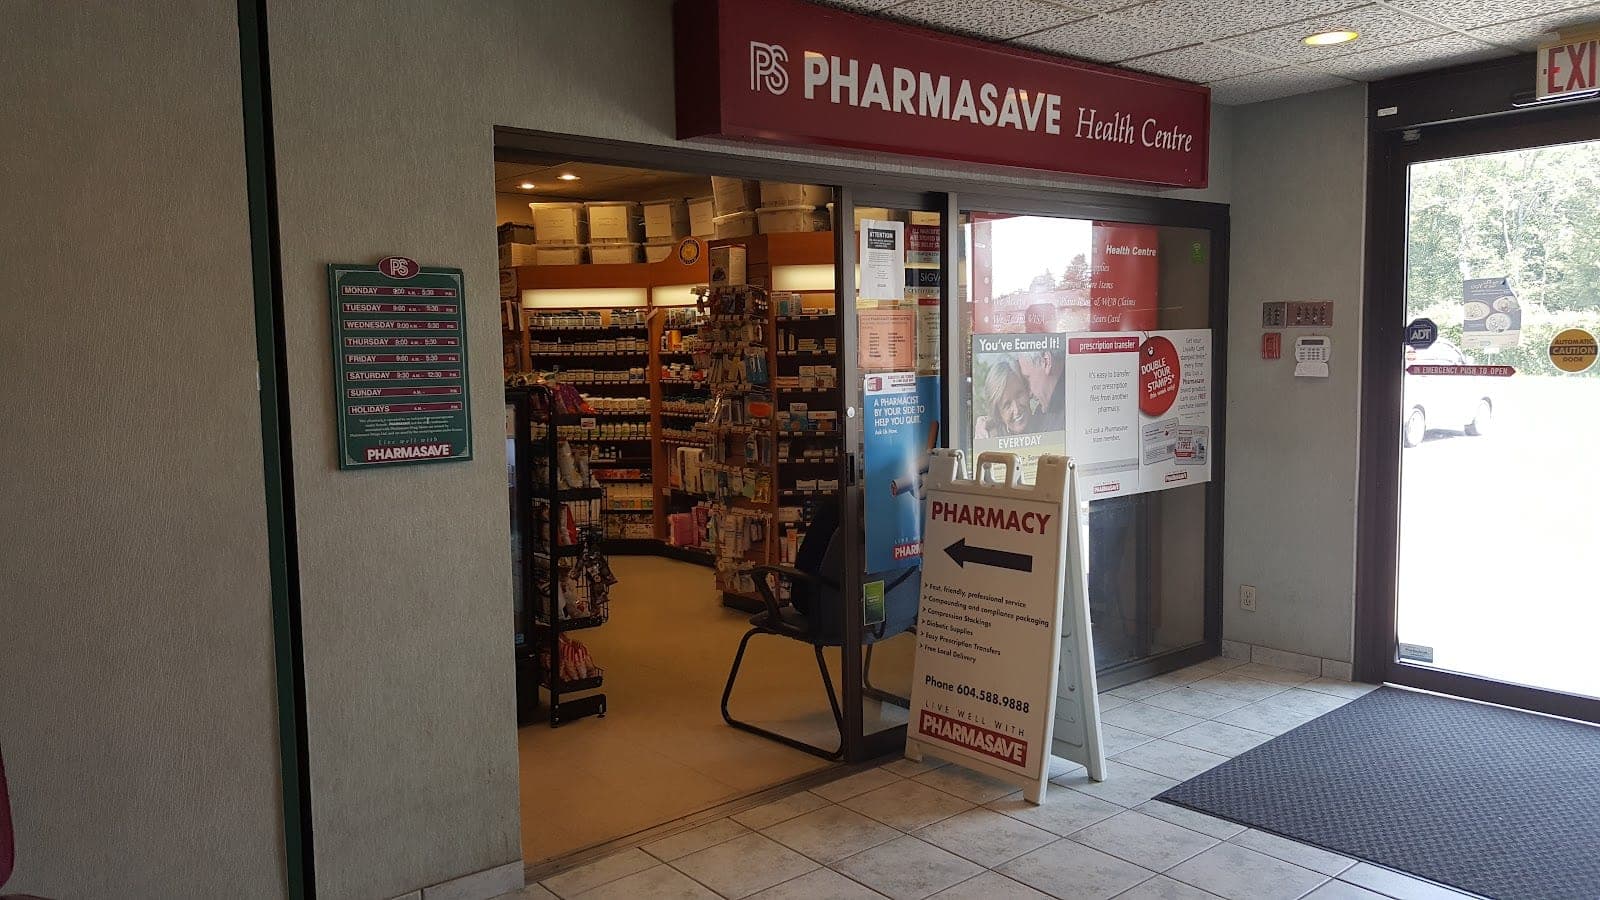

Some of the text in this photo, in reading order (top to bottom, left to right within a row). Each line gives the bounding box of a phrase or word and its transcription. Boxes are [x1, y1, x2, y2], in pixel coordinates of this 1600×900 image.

[1548, 41, 1600, 93] EXI
[750, 41, 1192, 152] PS PHARMASAVE Health Centre
[1106, 244, 1156, 256] Health Centre
[390, 258, 408, 276] PS
[1118, 297, 1136, 307] Claims
[1107, 314, 1121, 324] Card
[1411, 329, 1430, 340] ADT
[979, 337, 1060, 351] You've Earned It!
[1080, 340, 1135, 352] prescription transfer
[1552, 346, 1594, 354] CAUTION
[1141, 357, 1166, 375] DOUBLE
[1153, 366, 1171, 380] YOUR
[1423, 366, 1458, 374] EMERGENCY
[874, 396, 919, 407] A PHARMACIST
[874, 405, 925, 417] BY YOUR SIDE TO
[875, 418, 889, 427] HELP
[891, 416, 905, 425] YOU
[998, 435, 1042, 449] EVERYDAY
[368, 444, 450, 460] PHARMASAVE
[932, 501, 1051, 534] PHARMACY
[930, 584, 1026, 608] Fast, friendly, professional service
[928, 596, 1049, 627] Compounding and compliance packaging
[928, 608, 991, 628] Compression Stockings
[927, 620, 973, 636] Diabetic Supplies
[926, 632, 1000, 656] Easy Prescription Transfers
[938, 647, 952, 656] Local
[953, 651, 976, 663] Delivery
[926, 675, 1030, 713] Phone 604.588.9888
[926, 700, 1024, 736] LIVE WELL WITH
[923, 714, 1023, 760] PHARMASAVE
